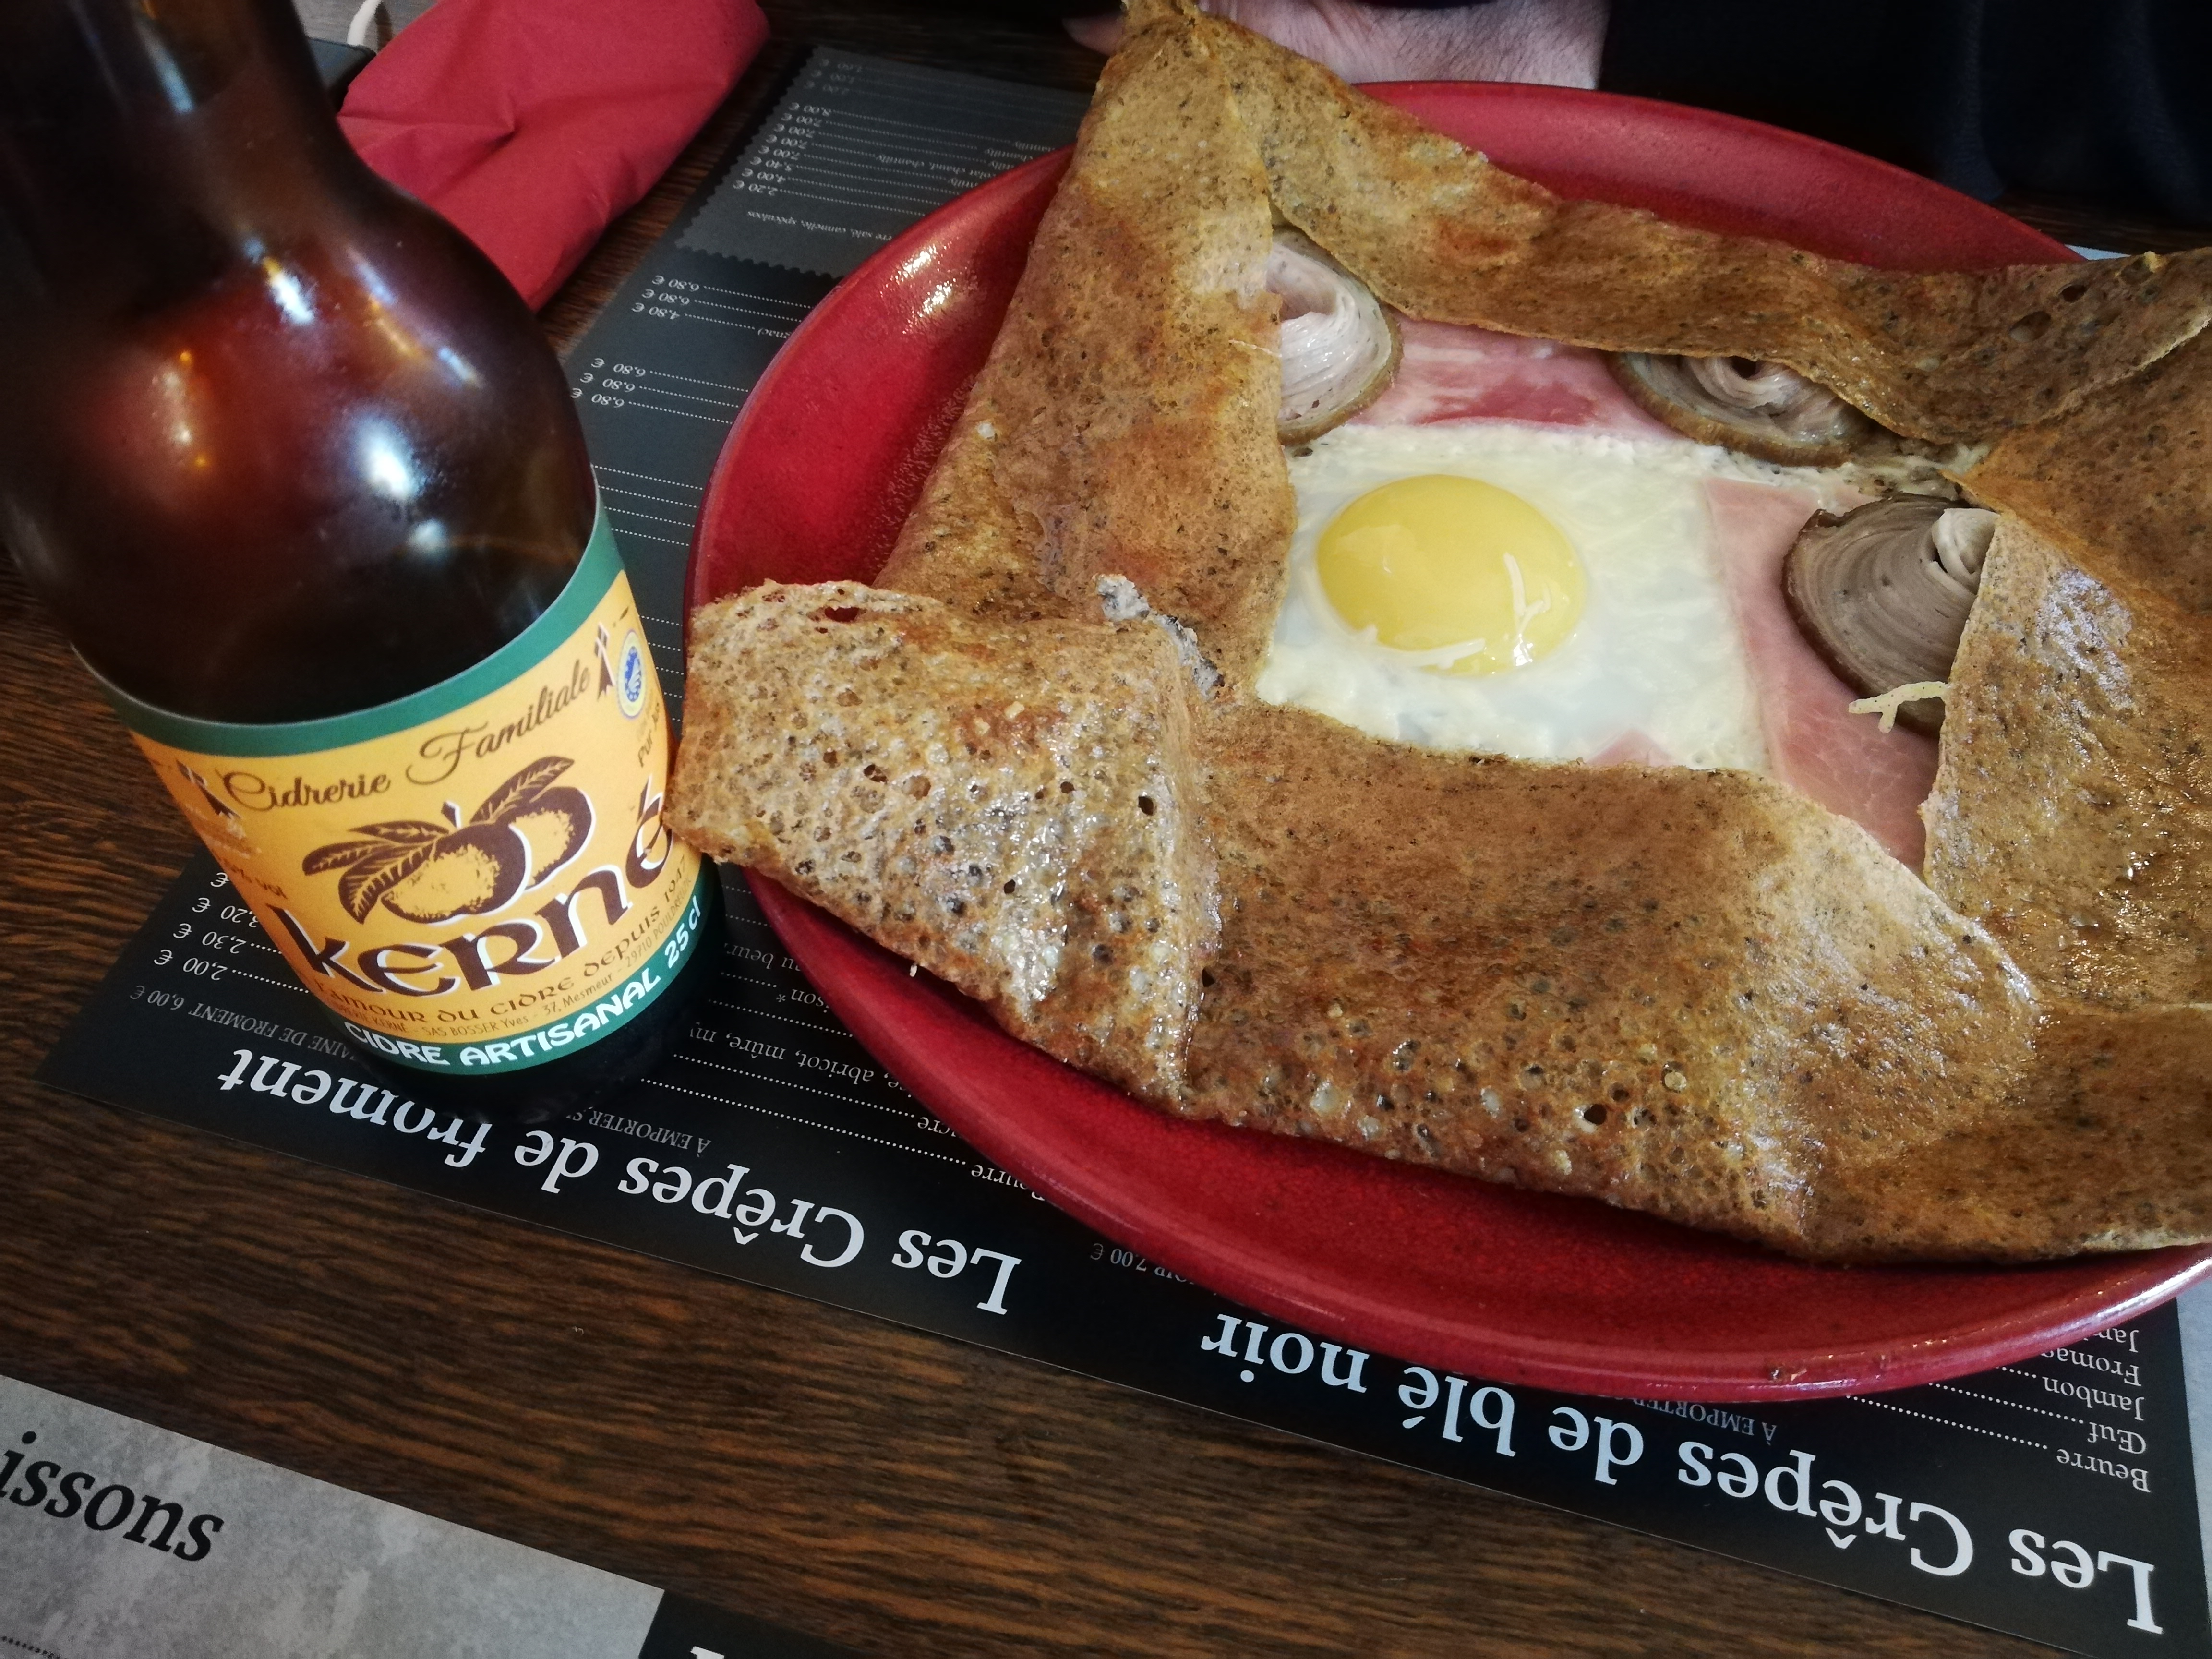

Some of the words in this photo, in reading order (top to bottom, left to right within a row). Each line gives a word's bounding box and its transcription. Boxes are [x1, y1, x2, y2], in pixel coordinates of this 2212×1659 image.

[788, 102, 800, 111] €
[781, 112, 793, 121] €
[772, 123, 785, 132] €
[765, 134, 778, 144] €
[757, 145, 770, 154] €
[749, 156, 762, 166] €
[877, 155, 925, 167] chantilly
[741, 168, 753, 177] €
[733, 180, 745, 190] €
[652, 275, 665, 285] €
[668, 279, 699, 292] 6,80
[641, 289, 655, 299] €
[658, 292, 690, 306] 6,80
[632, 303, 645, 313] €
[648, 306, 681, 320] 4,80
[591, 358, 605, 368] €
[613, 364, 646, 377] 6,80
[580, 373, 594, 383] €
[602, 378, 635, 392] 6,80
[570, 388, 583, 398] €
[591, 394, 625, 408] 6,80
[215, 768, 391, 812] Cidrerie
[406, 659, 590, 785] Familiale
[210, 872, 229, 887] €
[192, 897, 211, 913] €
[220, 905, 259, 928] 3,20
[173, 923, 192, 938] €
[202, 931, 246, 954] 2,30
[154, 949, 173, 965] €
[182, 957, 228, 981] 2,00
[130, 986, 145, 1000] €
[422, 1025, 447, 1036] SAS
[451, 1021, 496, 1036] BOSSER
[503, 1015, 529, 1029] Yves
[563, 973, 613, 1007] Mesmeur
[625, 936, 653, 968] 29710
[147, 990, 185, 1010] 6,00
[189, 1003, 276, 1039] FROMENT
[344, 1022, 451, 1066] CIDRE
[459, 967, 661, 1066] ARTISANAL
[437, 1009, 479, 1022] du
[279, 1028, 308, 1046] DE
[308, 1036, 356, 1061] AINE
[725, 1033, 787, 1061] mûre,
[795, 1050, 874, 1085] abricot,
[217, 1049, 492, 1168] froment
[589, 1110, 693, 1150] EMPORTER
[695, 1137, 712, 1158] À
[514, 1129, 600, 1192] de
[618, 1157, 866, 1268] Crêpes
[1089, 1242, 1105, 1261] €
[891, 1228, 1022, 1315] Les
[1200, 1313, 1370, 1394] noir
[2041, 1376, 2145, 1421] Jambon
[1398, 1364, 1516, 1457] blé
[1761, 1421, 1778, 1446] À
[2086, 1422, 2147, 1455] Œuf
[1548, 1406, 1645, 1486] de
[2056, 1448, 2152, 1493] Beurre
[1677, 1440, 1975, 1577] Crêpes
[2008, 1527, 2164, 1635] Les
